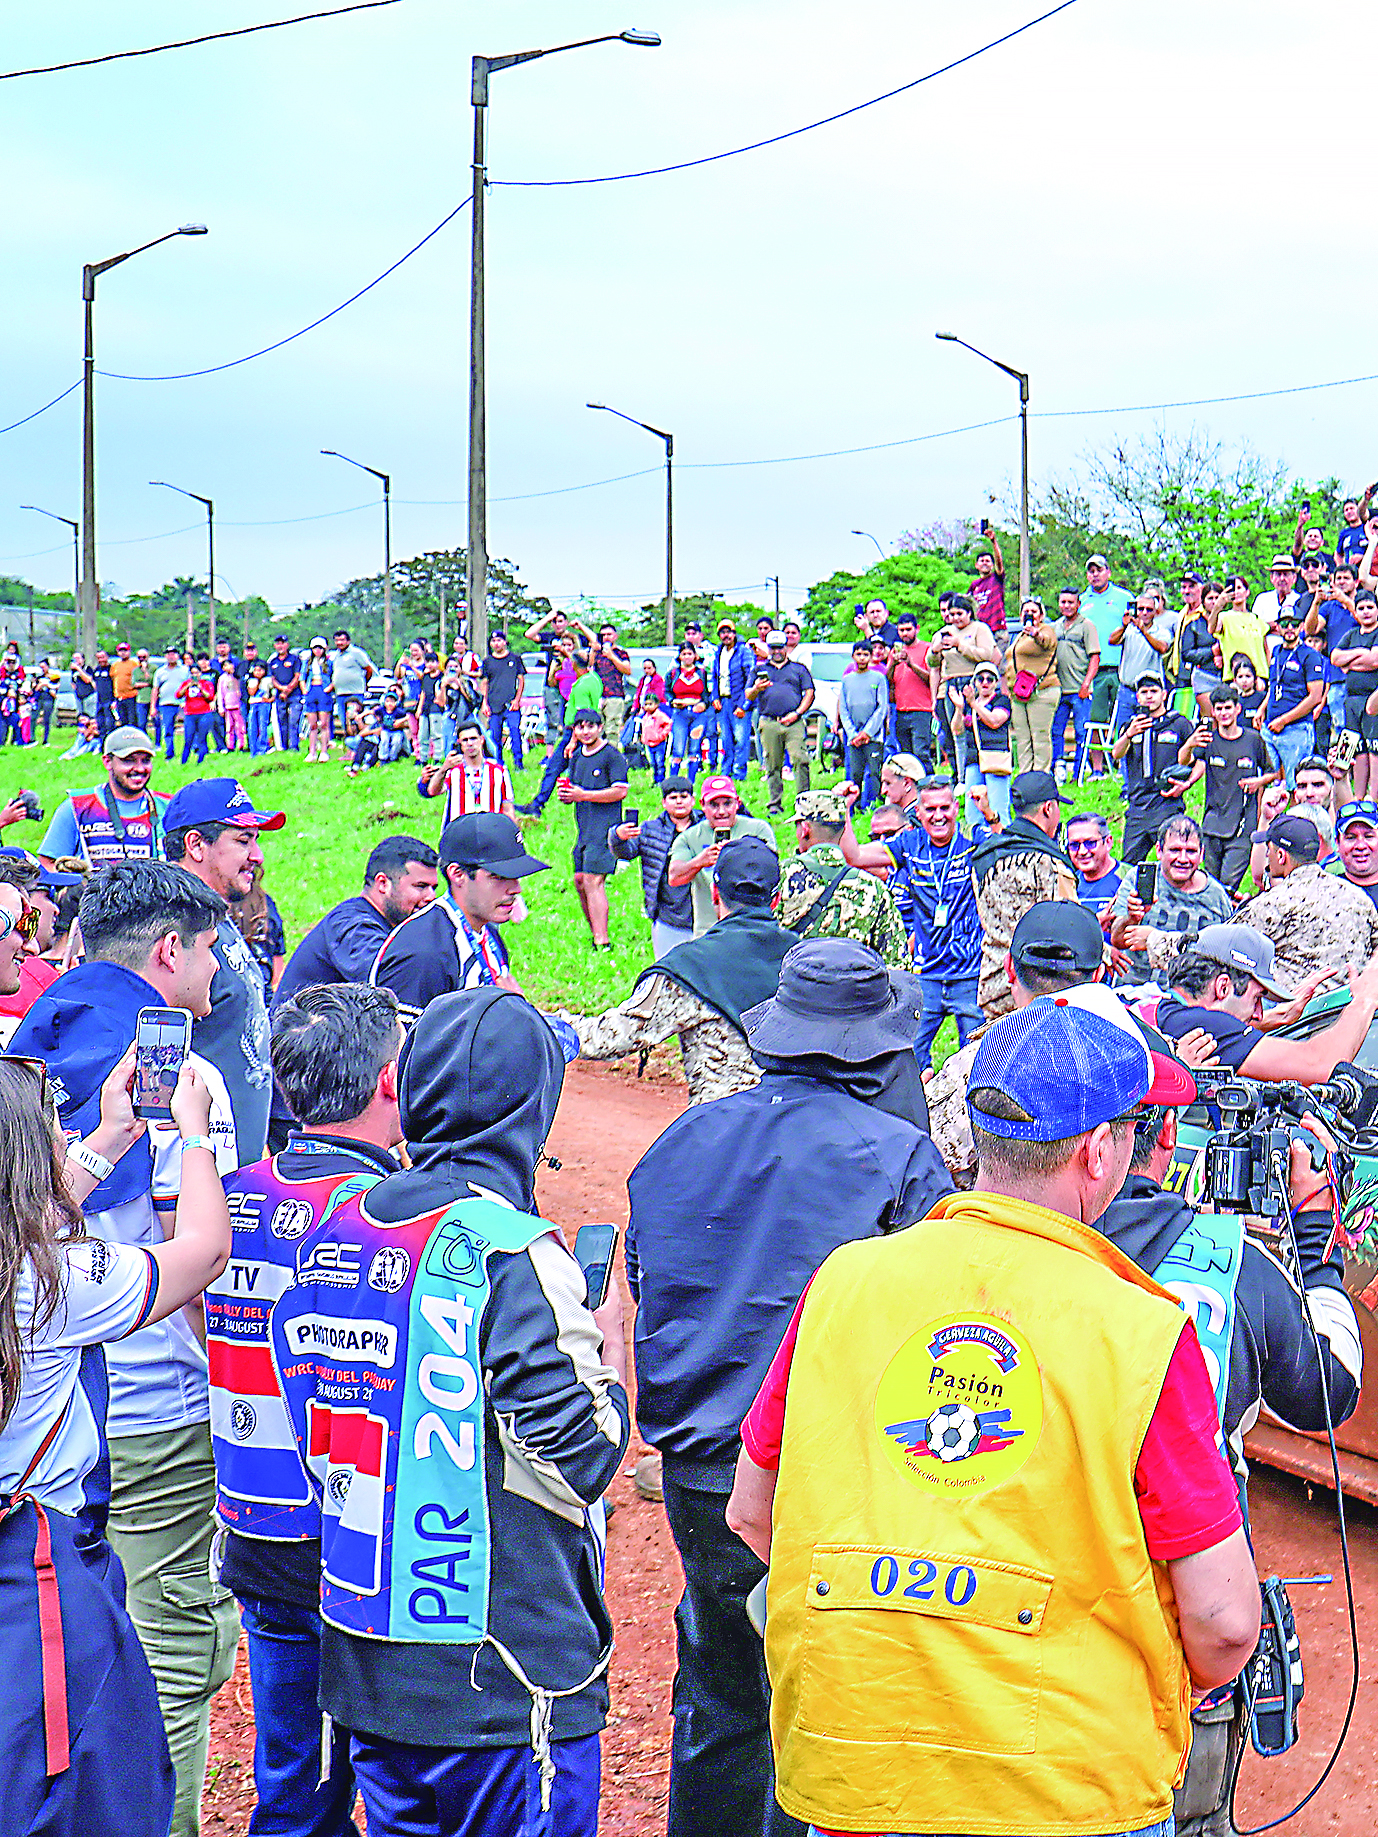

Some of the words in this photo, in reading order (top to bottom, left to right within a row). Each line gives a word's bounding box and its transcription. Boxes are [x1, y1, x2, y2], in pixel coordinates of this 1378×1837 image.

[1161, 1160, 1191, 1194] 27
[231, 1265, 261, 1293] TV
[243, 1306, 265, 1319] DEL
[938, 1326, 982, 1345] CERVEZA
[336, 1370, 360, 1383] DEL
[414, 1292, 479, 1472] 204
[928, 1366, 1004, 1398] Pasión
[927, 1385, 1001, 1409] Tricolor
[944, 1473, 987, 1488] Colombia
[408, 1502, 473, 1625] PAR
[869, 1554, 978, 1606] 020
